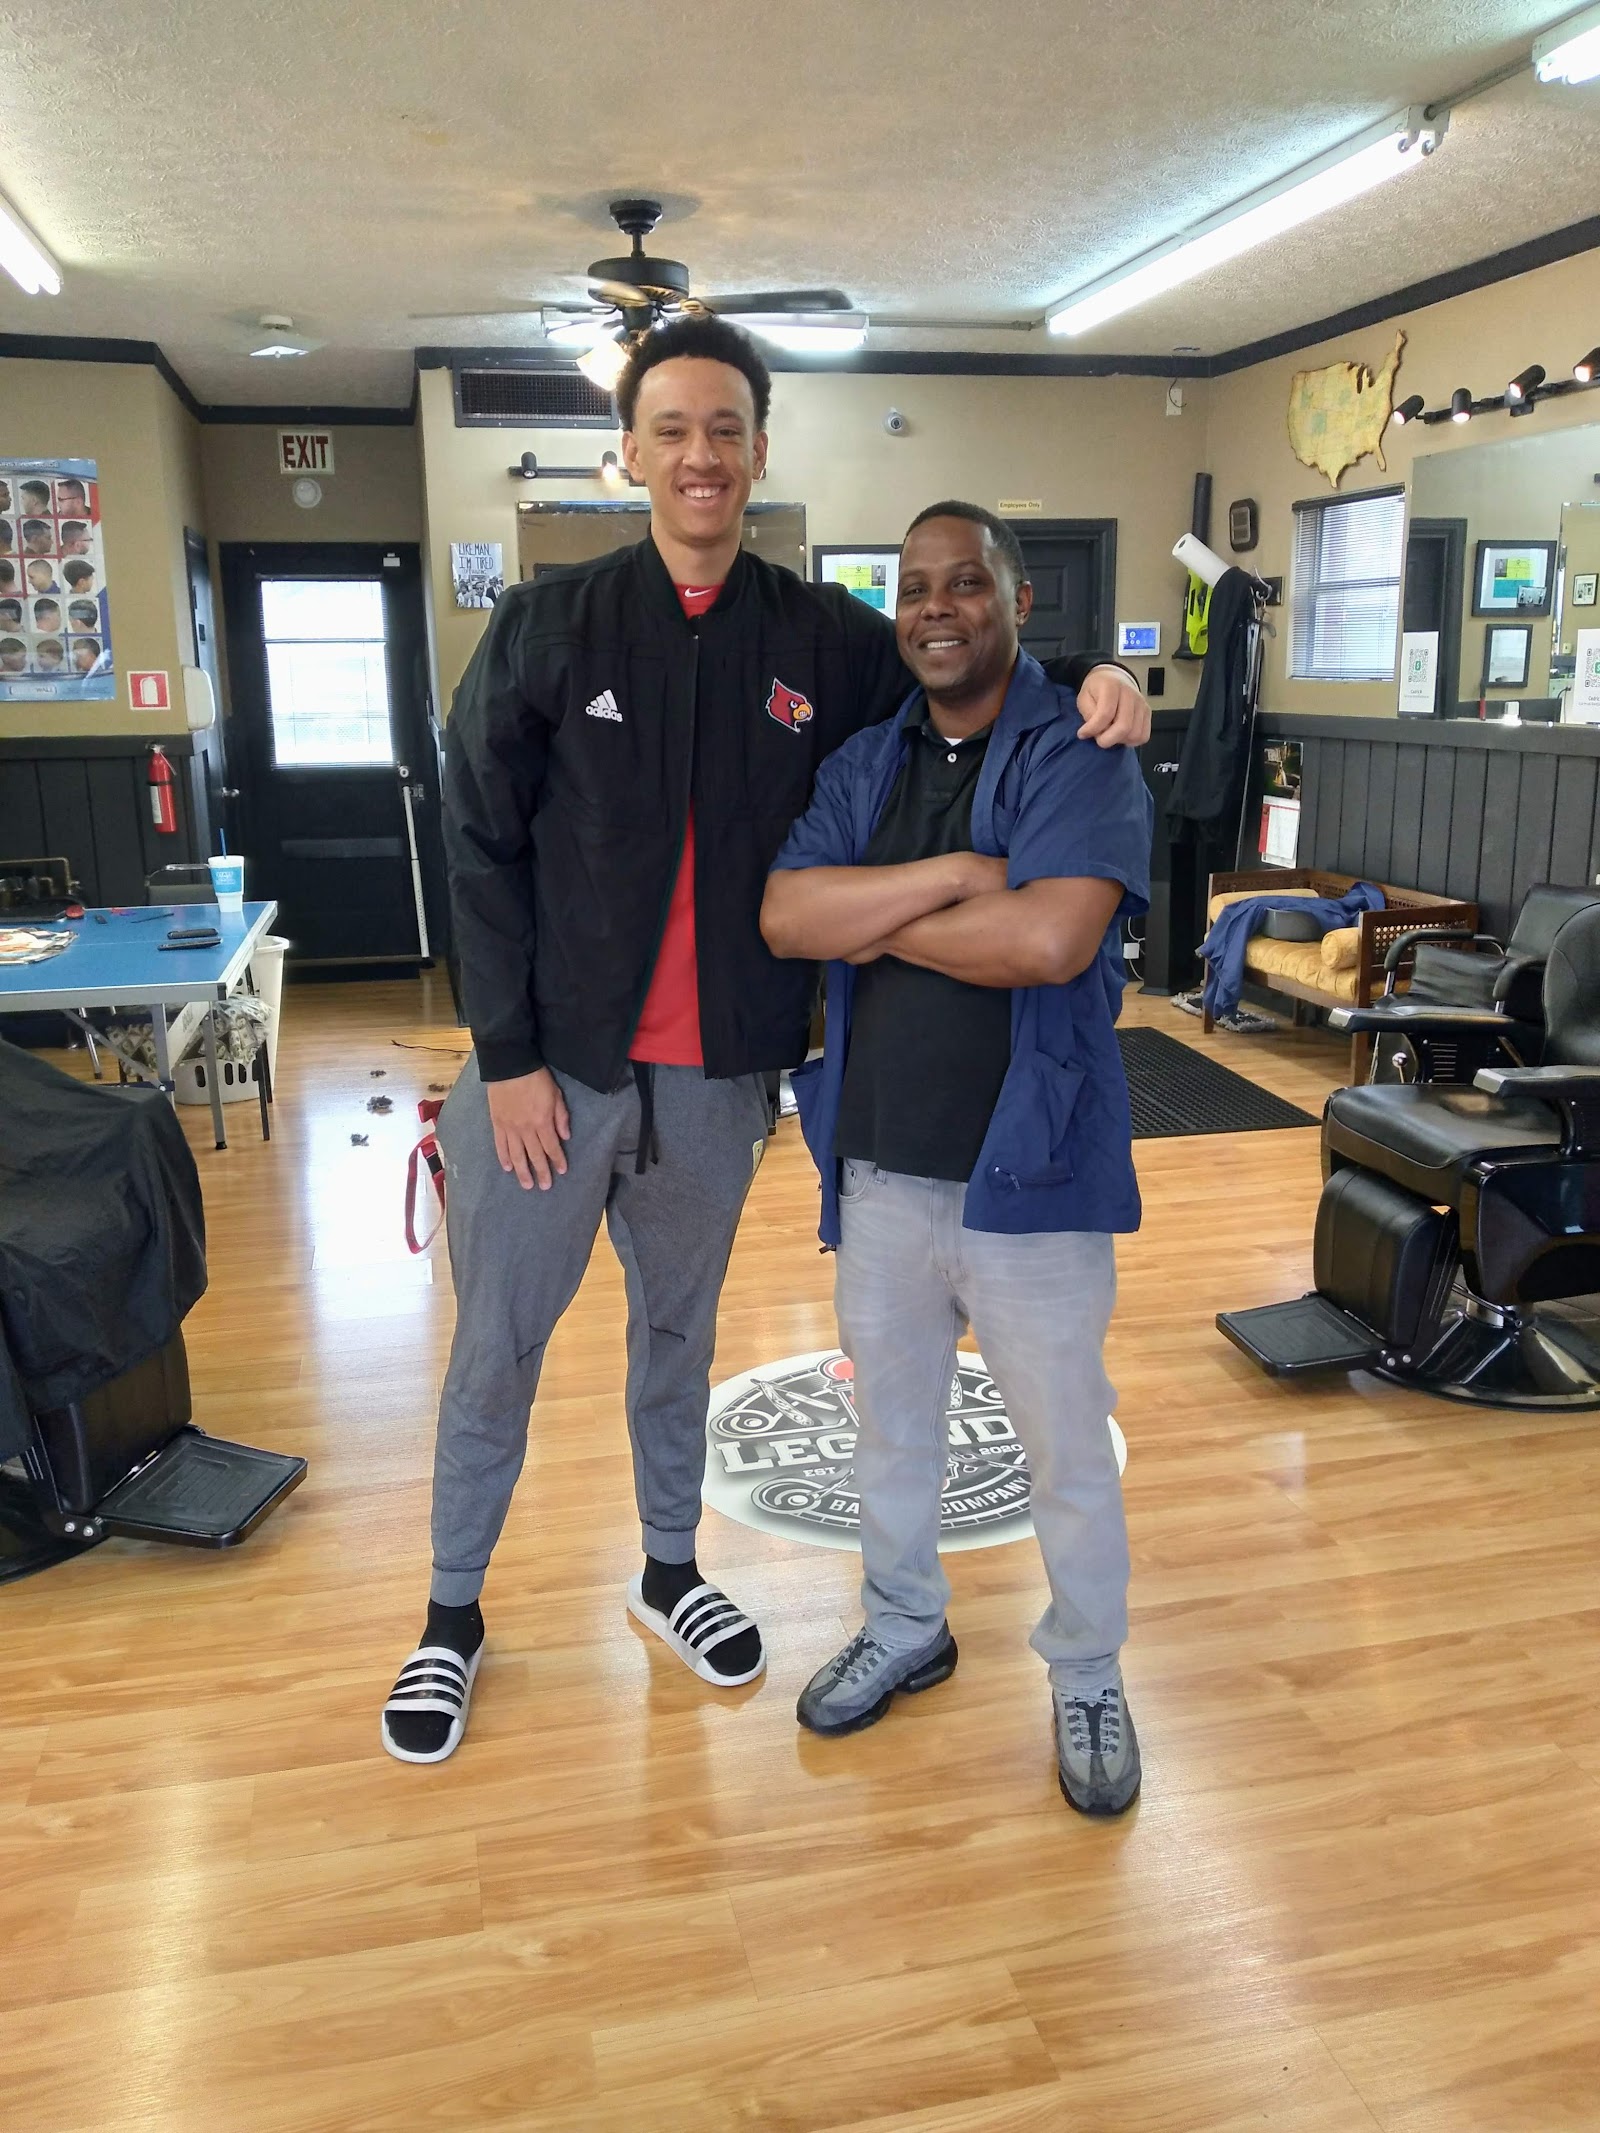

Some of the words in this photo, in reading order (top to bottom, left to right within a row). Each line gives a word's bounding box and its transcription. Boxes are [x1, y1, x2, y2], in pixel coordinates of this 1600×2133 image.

[282, 434, 329, 469] EXIT
[585, 705, 623, 722] adidas
[979, 1444, 1025, 1456] 2020
[803, 1466, 836, 1477] EST
